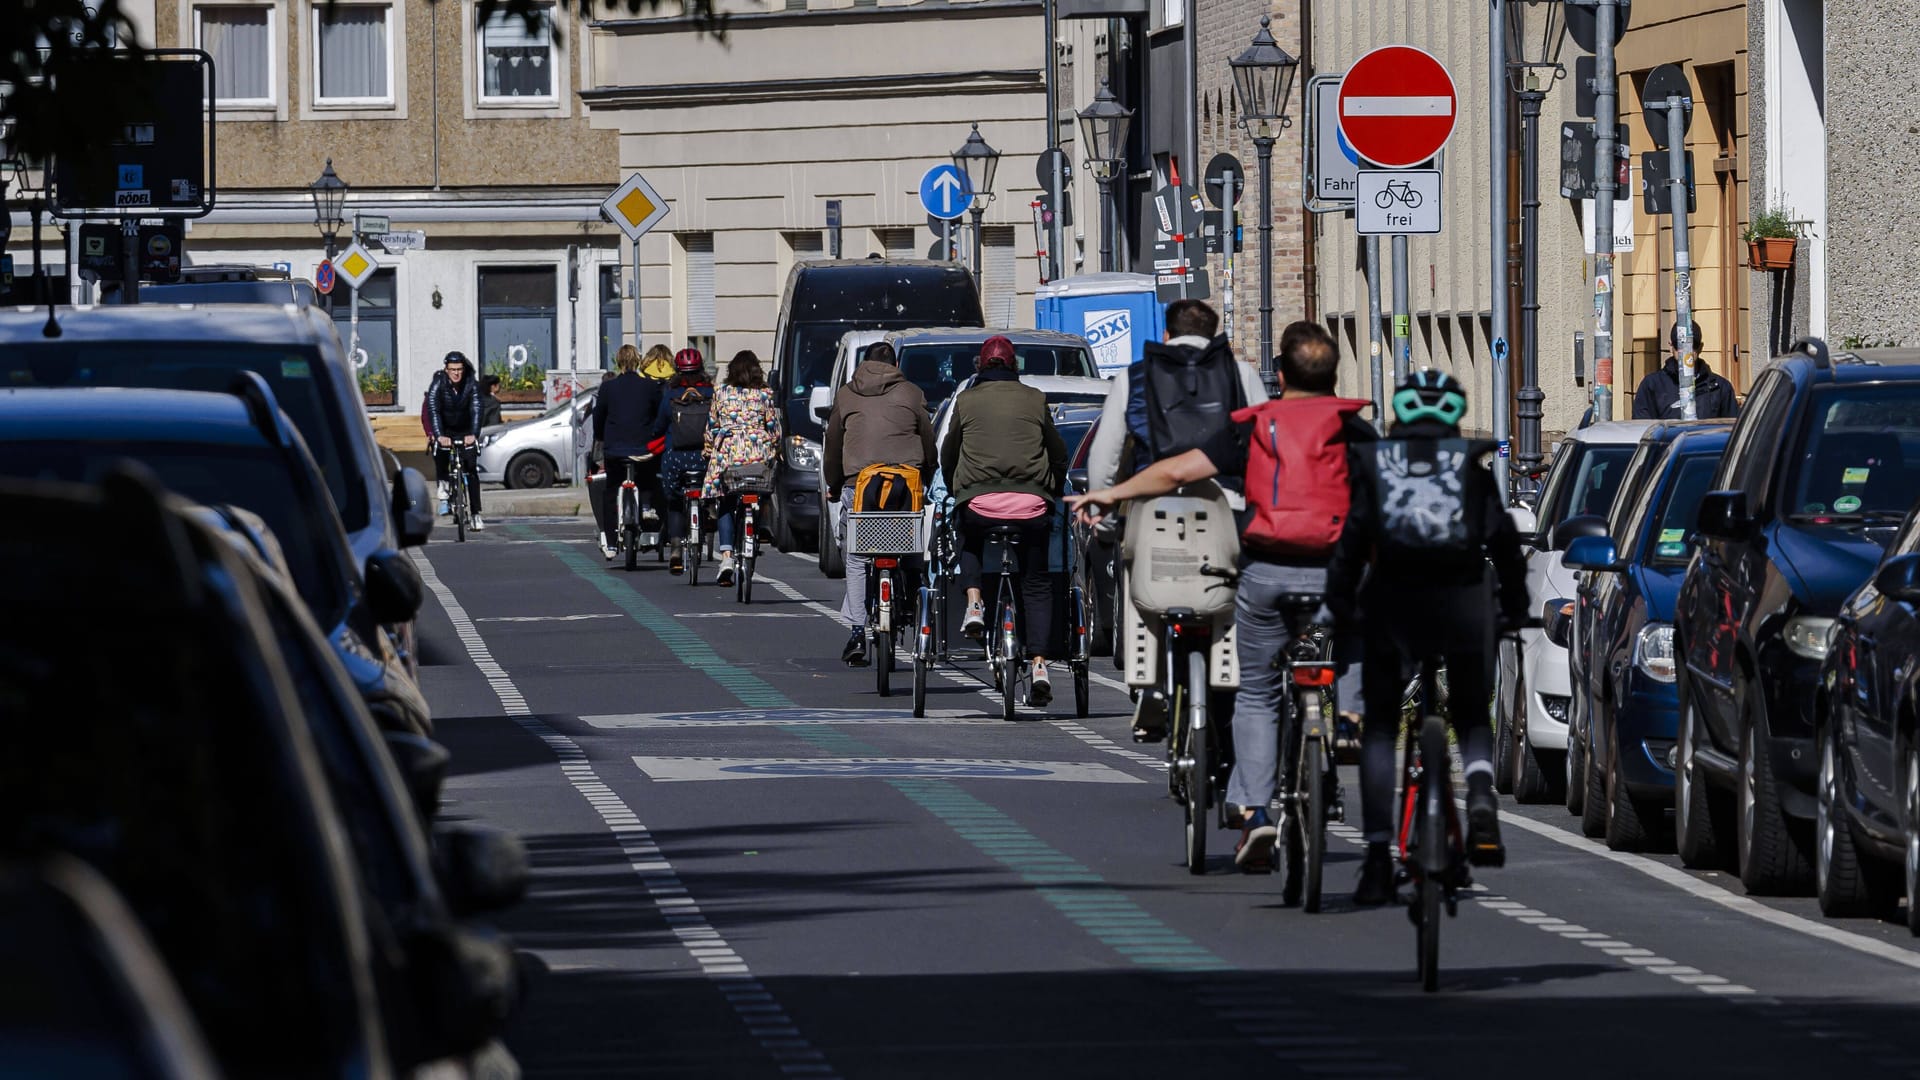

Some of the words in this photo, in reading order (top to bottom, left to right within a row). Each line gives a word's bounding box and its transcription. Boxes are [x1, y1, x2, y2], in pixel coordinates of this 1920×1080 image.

[1324, 178, 1355, 190] Fahr
[118, 192, 149, 204] RÖDEL
[1387, 213, 1412, 226] frei
